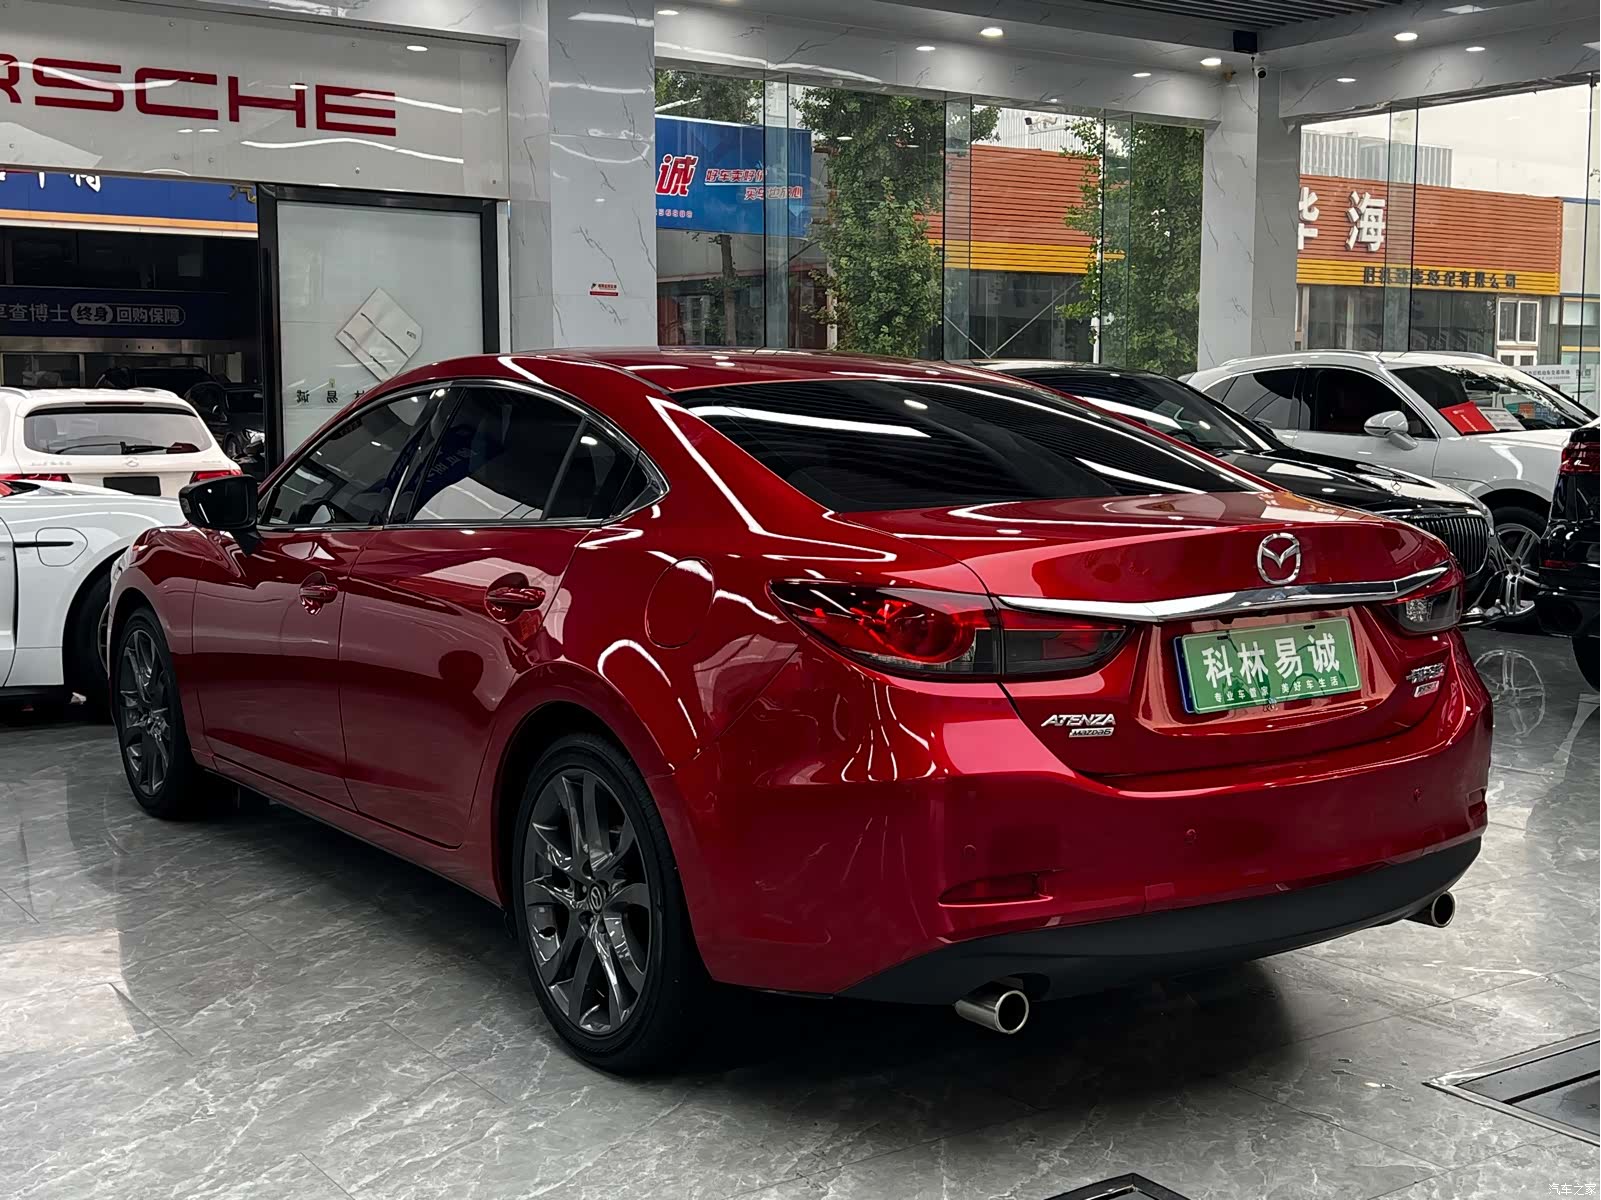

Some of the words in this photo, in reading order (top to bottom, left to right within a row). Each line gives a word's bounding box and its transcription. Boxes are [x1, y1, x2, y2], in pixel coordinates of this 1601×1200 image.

[0, 53, 397, 137] SCHE
[655, 154, 699, 197] 诚
[1202, 632, 1340, 689] 科林易诚
[1214, 686, 1269, 703] 专业车管家
[1281, 675, 1339, 694] 美好车生活
[1041, 713, 1116, 727] ATENZA
